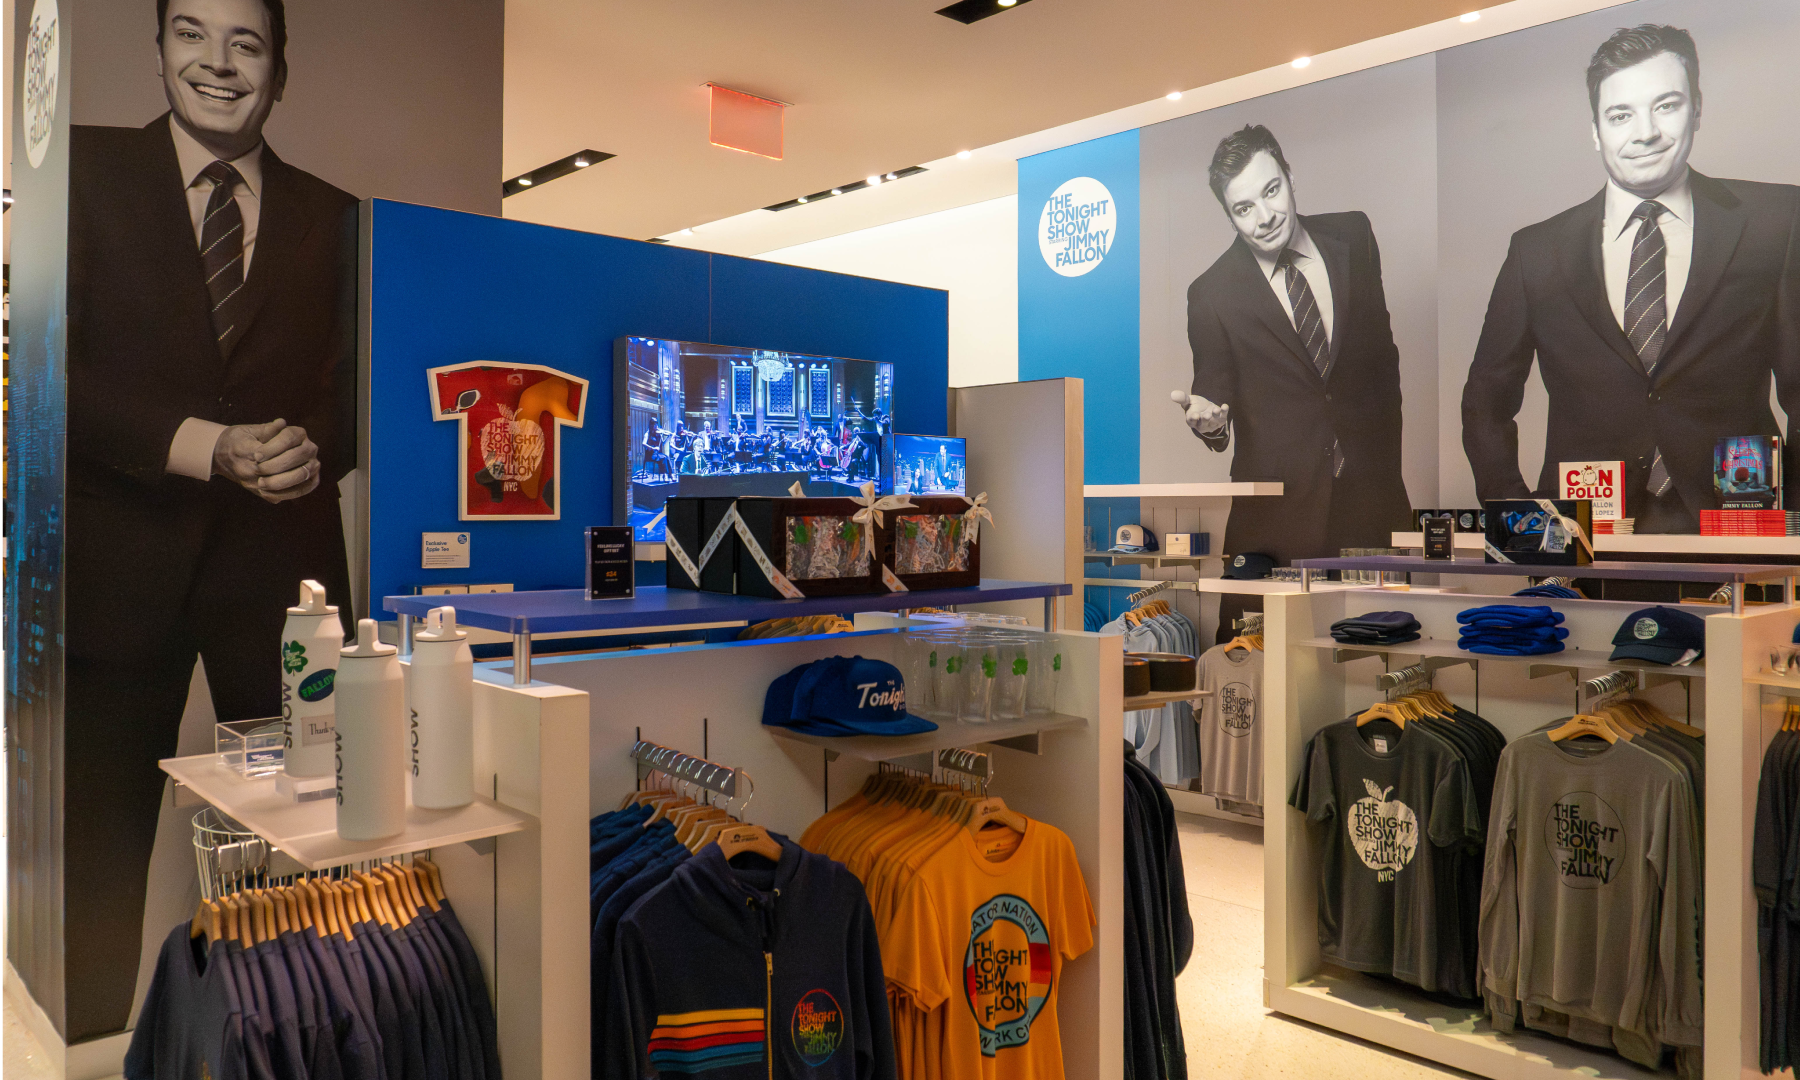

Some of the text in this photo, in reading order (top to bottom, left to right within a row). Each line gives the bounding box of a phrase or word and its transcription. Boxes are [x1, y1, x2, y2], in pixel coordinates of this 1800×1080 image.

[1048, 193, 1073, 211] THE
[1047, 199, 1109, 225] TONIGHT
[1047, 218, 1090, 240] SHOW
[1064, 229, 1109, 251] JIMMY
[1056, 244, 1106, 267] FALLON
[489, 421, 509, 433] THE
[488, 432, 538, 444] TONIGHT
[487, 443, 523, 455] SHOW
[502, 453, 538, 466] JIMMY
[493, 464, 535, 476] FALLON
[503, 481, 518, 491] NYC
[1567, 487, 1613, 498] POLLO
[857, 682, 905, 711] Tonigh
[1222, 687, 1237, 697] THE
[282, 681, 292, 749] SHOW
[1221, 703, 1246, 714] SHOW
[411, 708, 419, 778] SHOW
[335, 731, 343, 806] SHOW
[1356, 802, 1379, 815] THE
[1554, 803, 1580, 819] THE
[1355, 814, 1412, 833] TONIGHT
[1554, 816, 1619, 842] TONIGHT
[1356, 826, 1397, 840] SHOW
[1556, 832, 1599, 850] SHOW
[1377, 870, 1395, 882] NYC
[1001, 901, 1038, 935] NATION
[973, 940, 995, 958] TH
[974, 949, 1028, 974] TOIGHT
[799, 1002, 814, 1013] THE
[798, 1011, 837, 1024] TONIGHT
